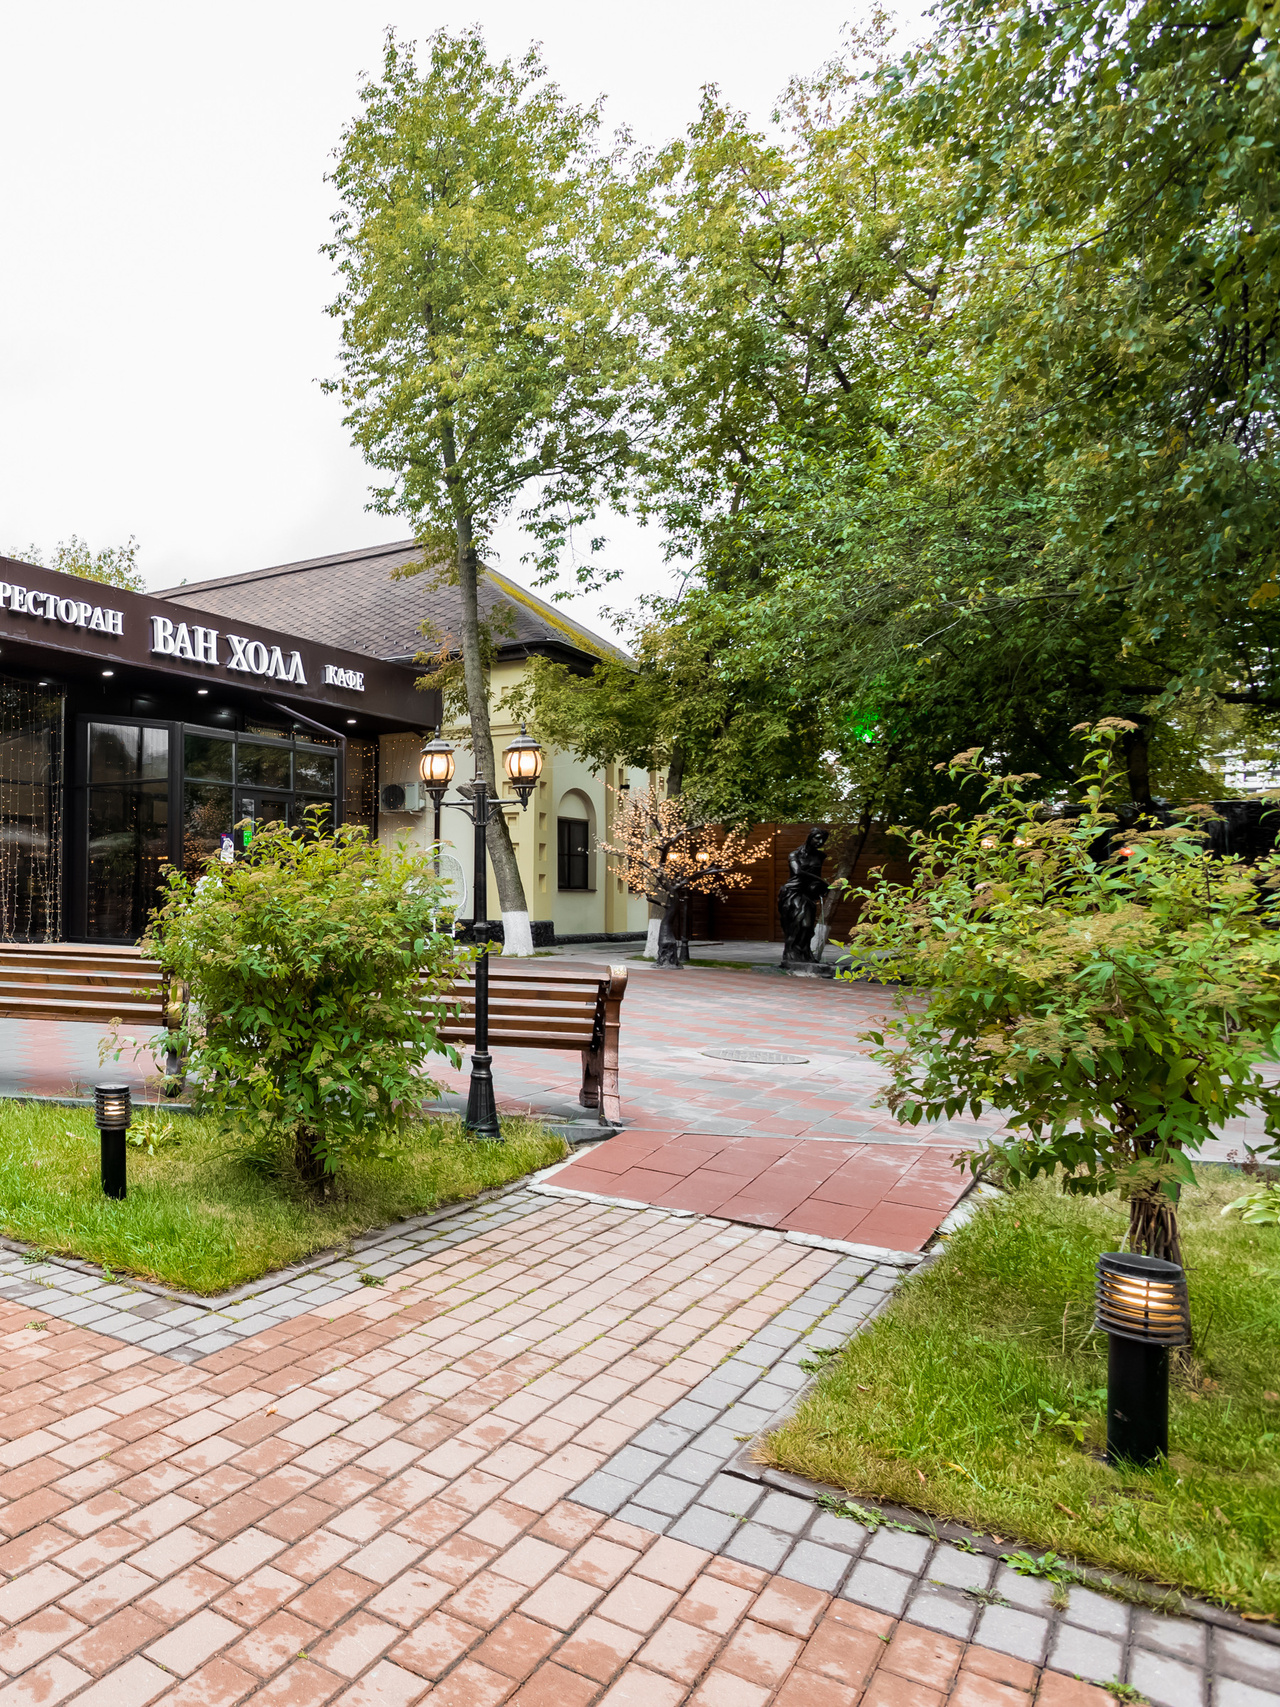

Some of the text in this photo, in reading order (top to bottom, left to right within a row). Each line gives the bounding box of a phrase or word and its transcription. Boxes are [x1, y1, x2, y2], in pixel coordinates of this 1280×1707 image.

[150, 615, 308, 685] ВАН ХОЛЛ
[324, 664, 365, 692] КАФЕ
